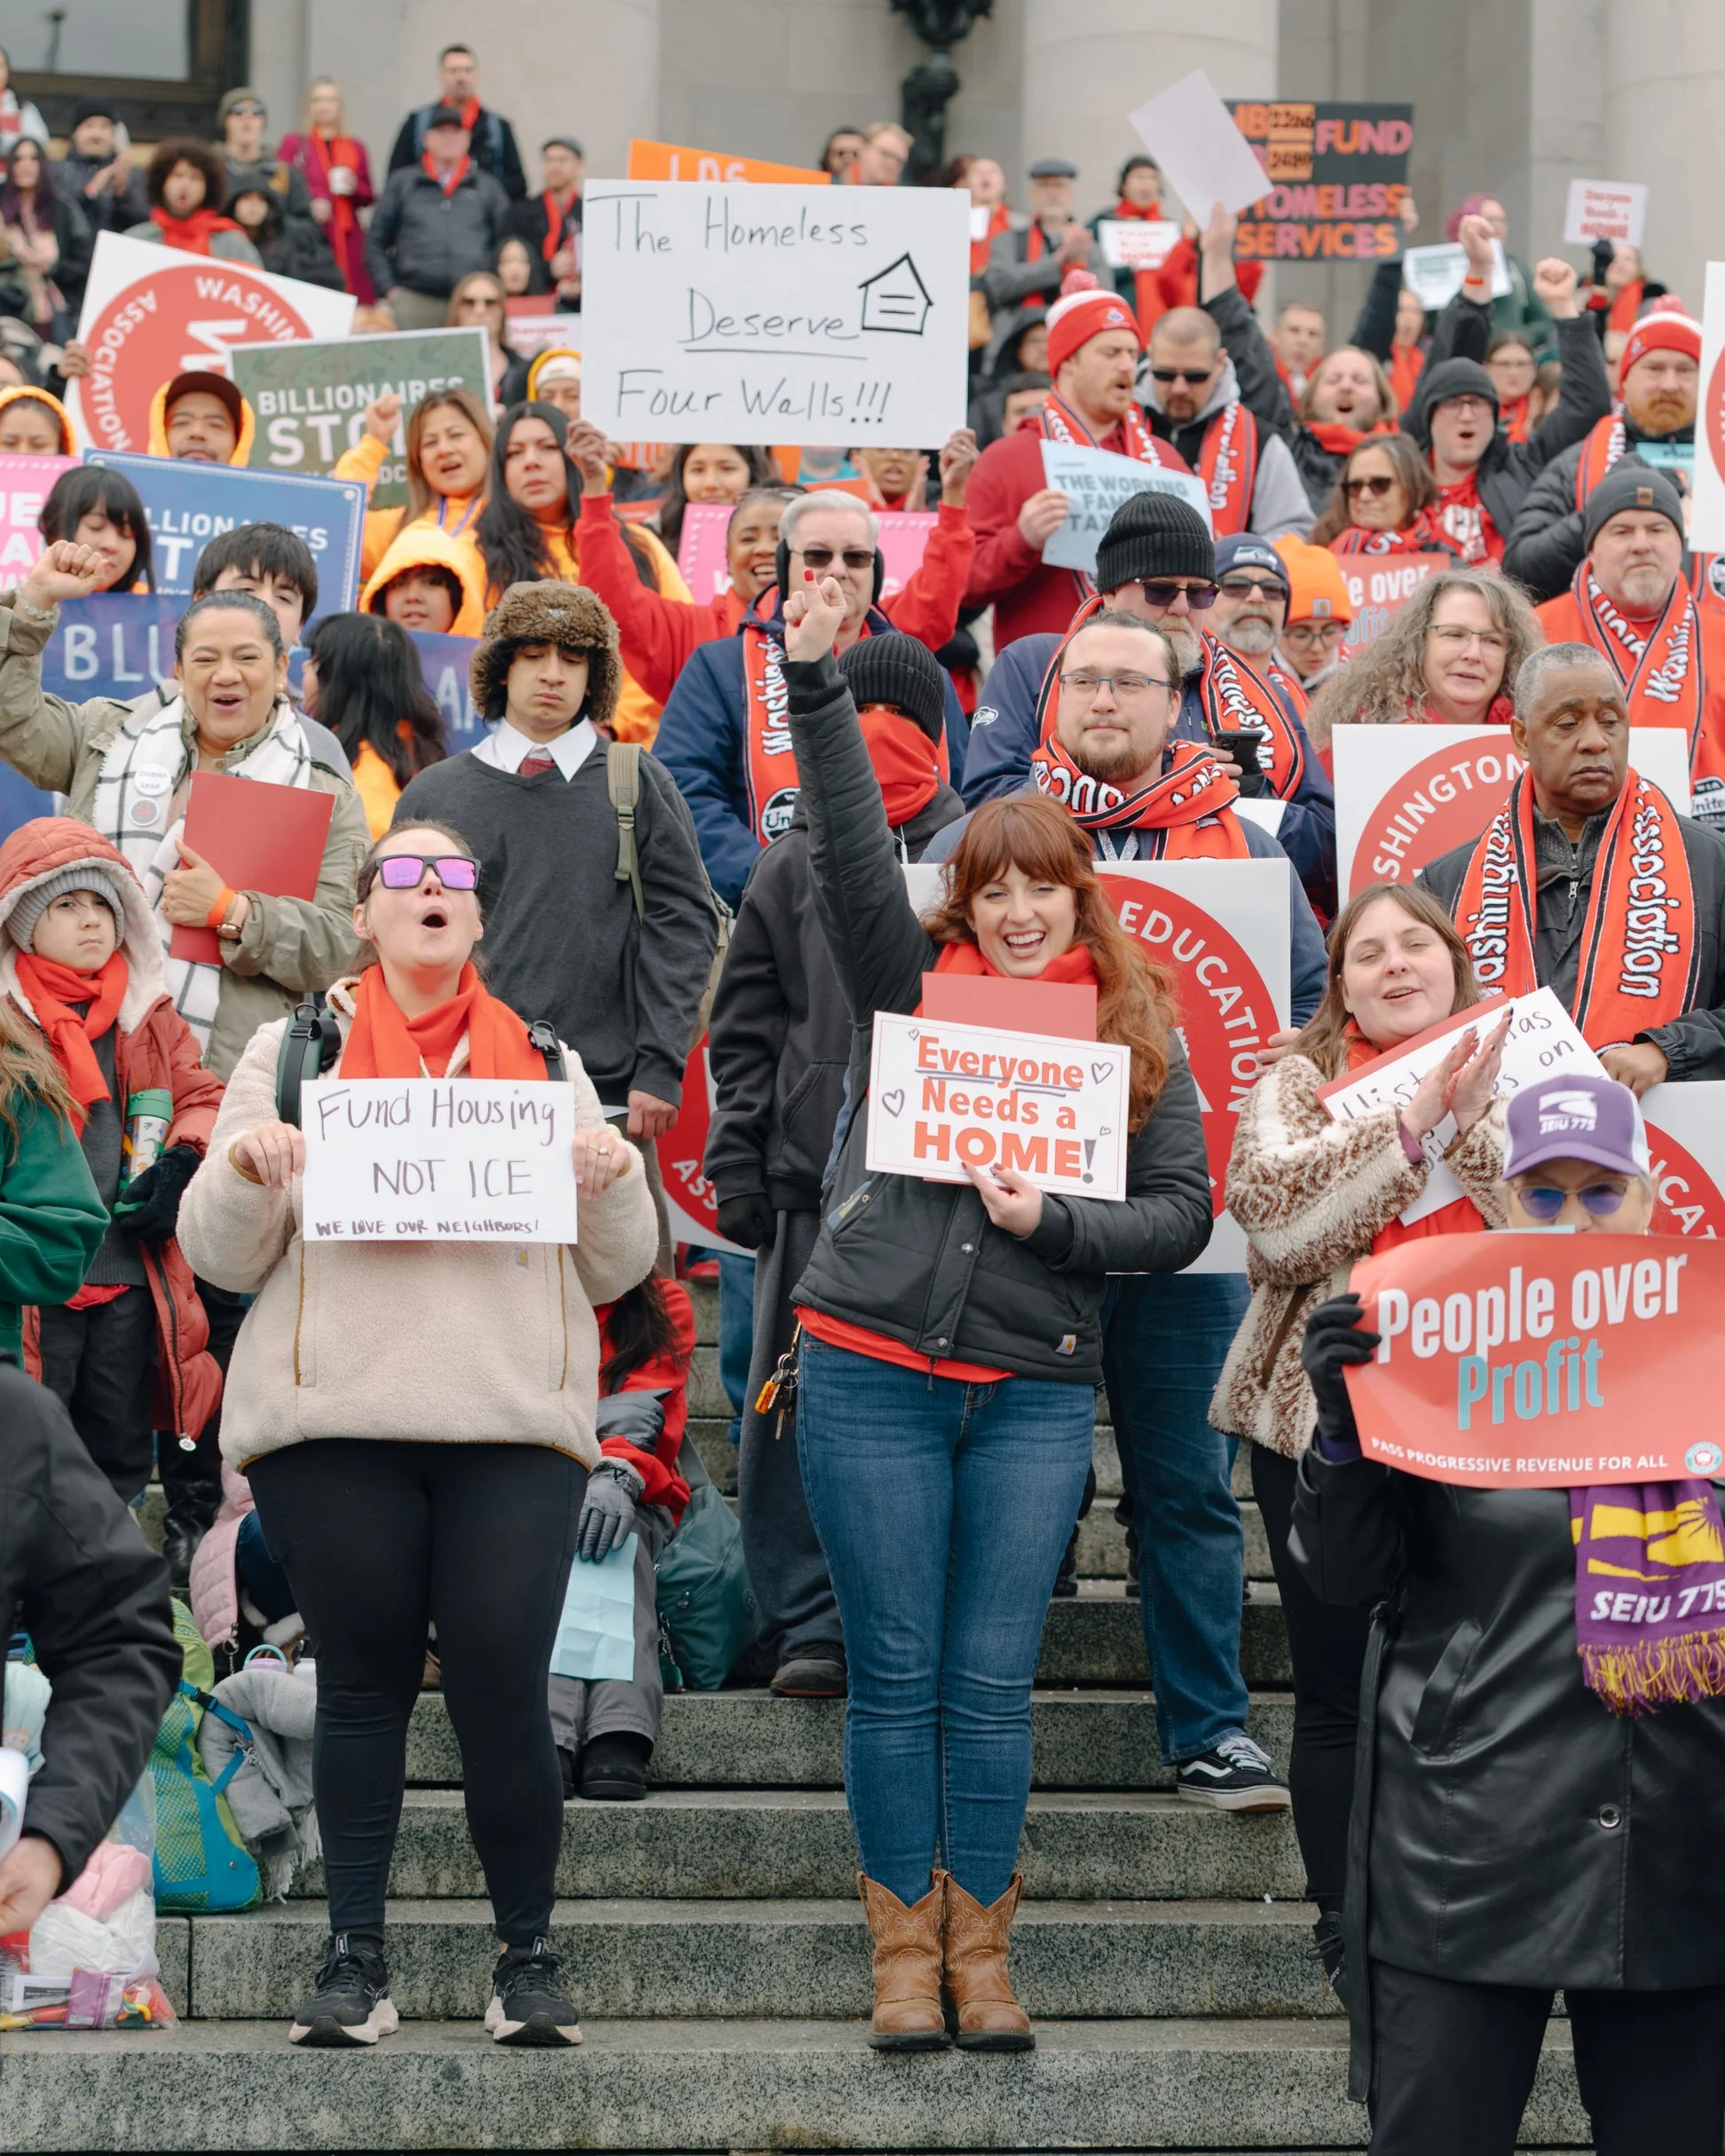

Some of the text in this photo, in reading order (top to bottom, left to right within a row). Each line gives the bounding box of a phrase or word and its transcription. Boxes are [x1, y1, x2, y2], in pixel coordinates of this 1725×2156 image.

[1314, 120, 1413, 155] FUND
[587, 193, 869, 254] The Homeless
[1234, 222, 1398, 258] SERVICES
[193, 275, 303, 342] WASHIN
[676, 287, 861, 344] Deserve
[91, 288, 158, 452] ASSOCIATION
[617, 369, 722, 417] Four
[1055, 474, 1189, 496] THE WORKING
[1372, 752, 1532, 885] SHINGTON
[918, 1035, 1084, 1090] Everyone
[1539, 1039, 1575, 1067] on
[430, 1085, 555, 1147] Housing
[921, 1078, 1076, 1130] Needs a
[1540, 1117, 1596, 1135] SEIU 775
[373, 1159, 533, 1199] NOT ICE
[315, 1220, 344, 1237] WE
[351, 1220, 386, 1236] LOVE
[396, 1219, 429, 1235] OUR
[1376, 1253, 1689, 1365] People over
[1458, 1335, 1605, 1432] Profit
[1371, 1436, 1405, 1460] PASS
[1406, 1447, 1512, 1474] PROGRESSIVE
[1516, 1455, 1595, 1473] REVENUE
[1598, 1454, 1633, 1470] FOR
[1636, 1453, 1668, 1469] ALL
[1589, 1578, 1725, 1624] SEIU 775
